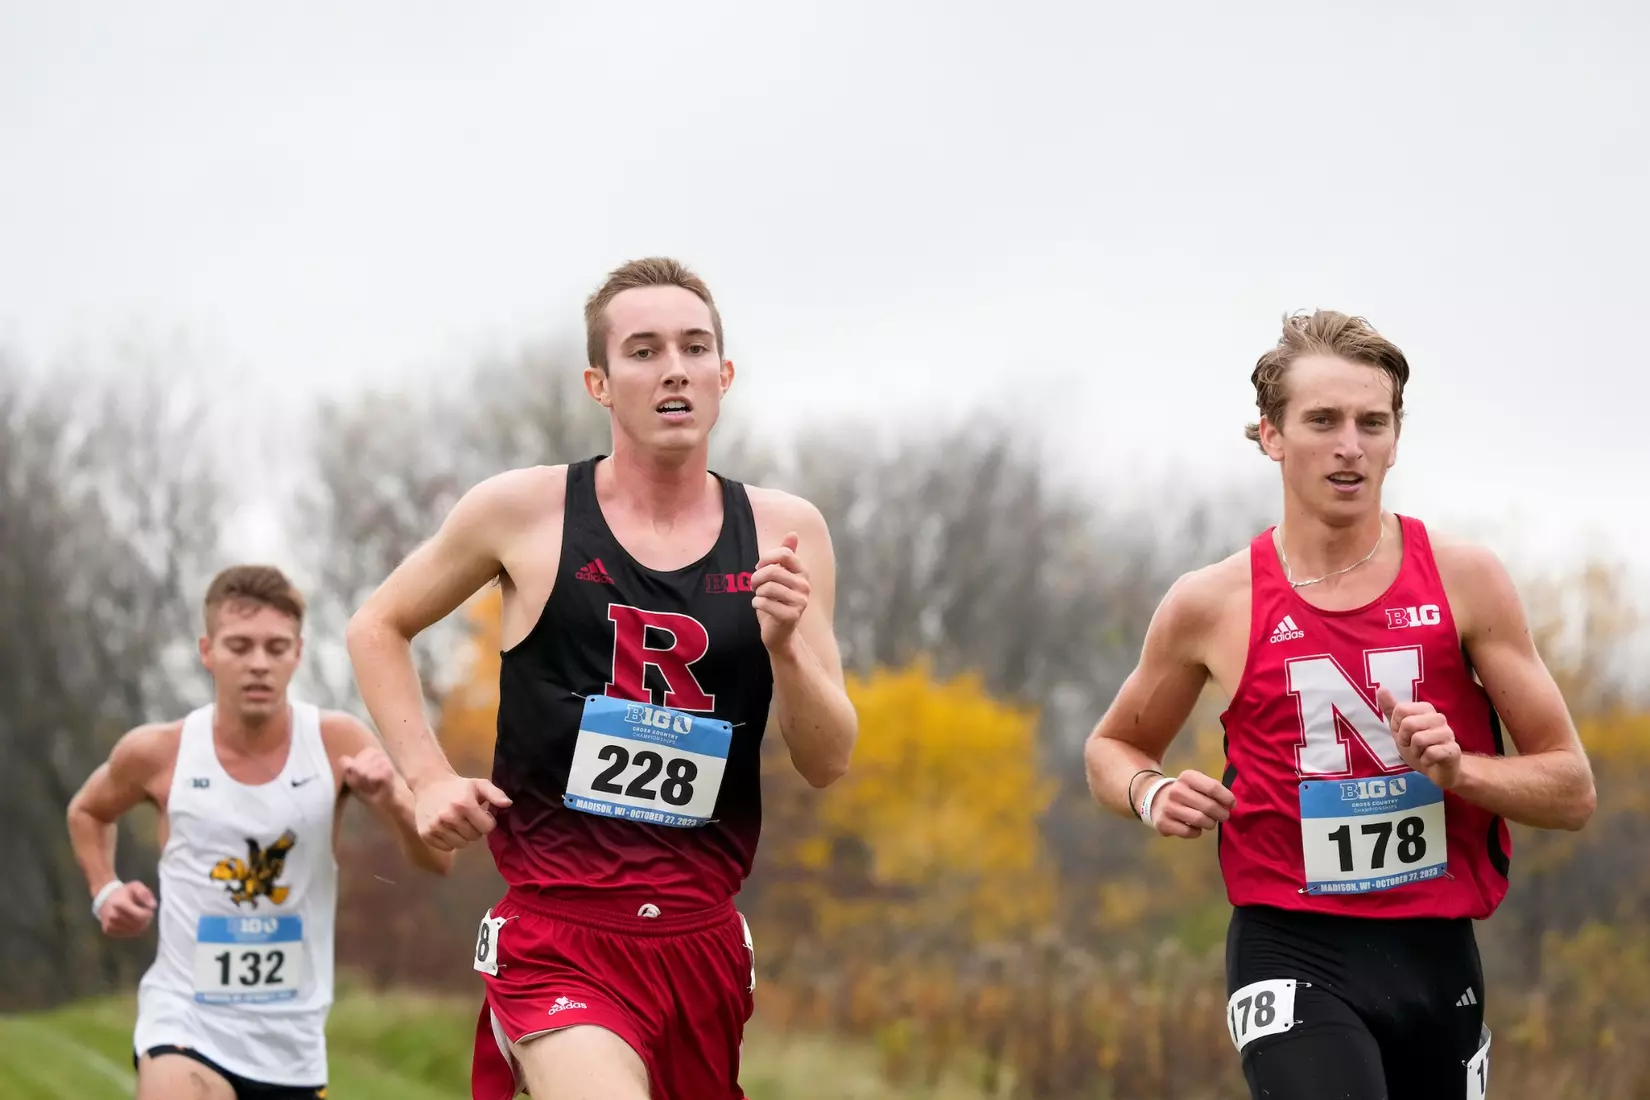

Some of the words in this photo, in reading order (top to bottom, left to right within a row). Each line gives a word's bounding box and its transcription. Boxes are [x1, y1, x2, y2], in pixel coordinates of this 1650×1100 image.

[575, 571, 615, 585] adidas
[1269, 629, 1305, 644] adidas
[604, 603, 715, 712] R
[1284, 644, 1424, 778] N
[652, 729, 679, 741] COUNTRY
[591, 745, 697, 806] 228
[1371, 799, 1398, 807] COUNTRY
[614, 807, 626, 817] WI
[629, 810, 664, 823] OCTOBER
[665, 815, 676, 826] 27,
[677, 817, 697, 827] 2023
[1328, 816, 1427, 872] 178
[1360, 882, 1371, 890] WI
[1375, 875, 1408, 888] OCTOBER
[1419, 867, 1438, 879] 2023
[478, 922, 489, 962] 8
[215, 950, 284, 985] 132
[548, 1001, 587, 1016] adidas
